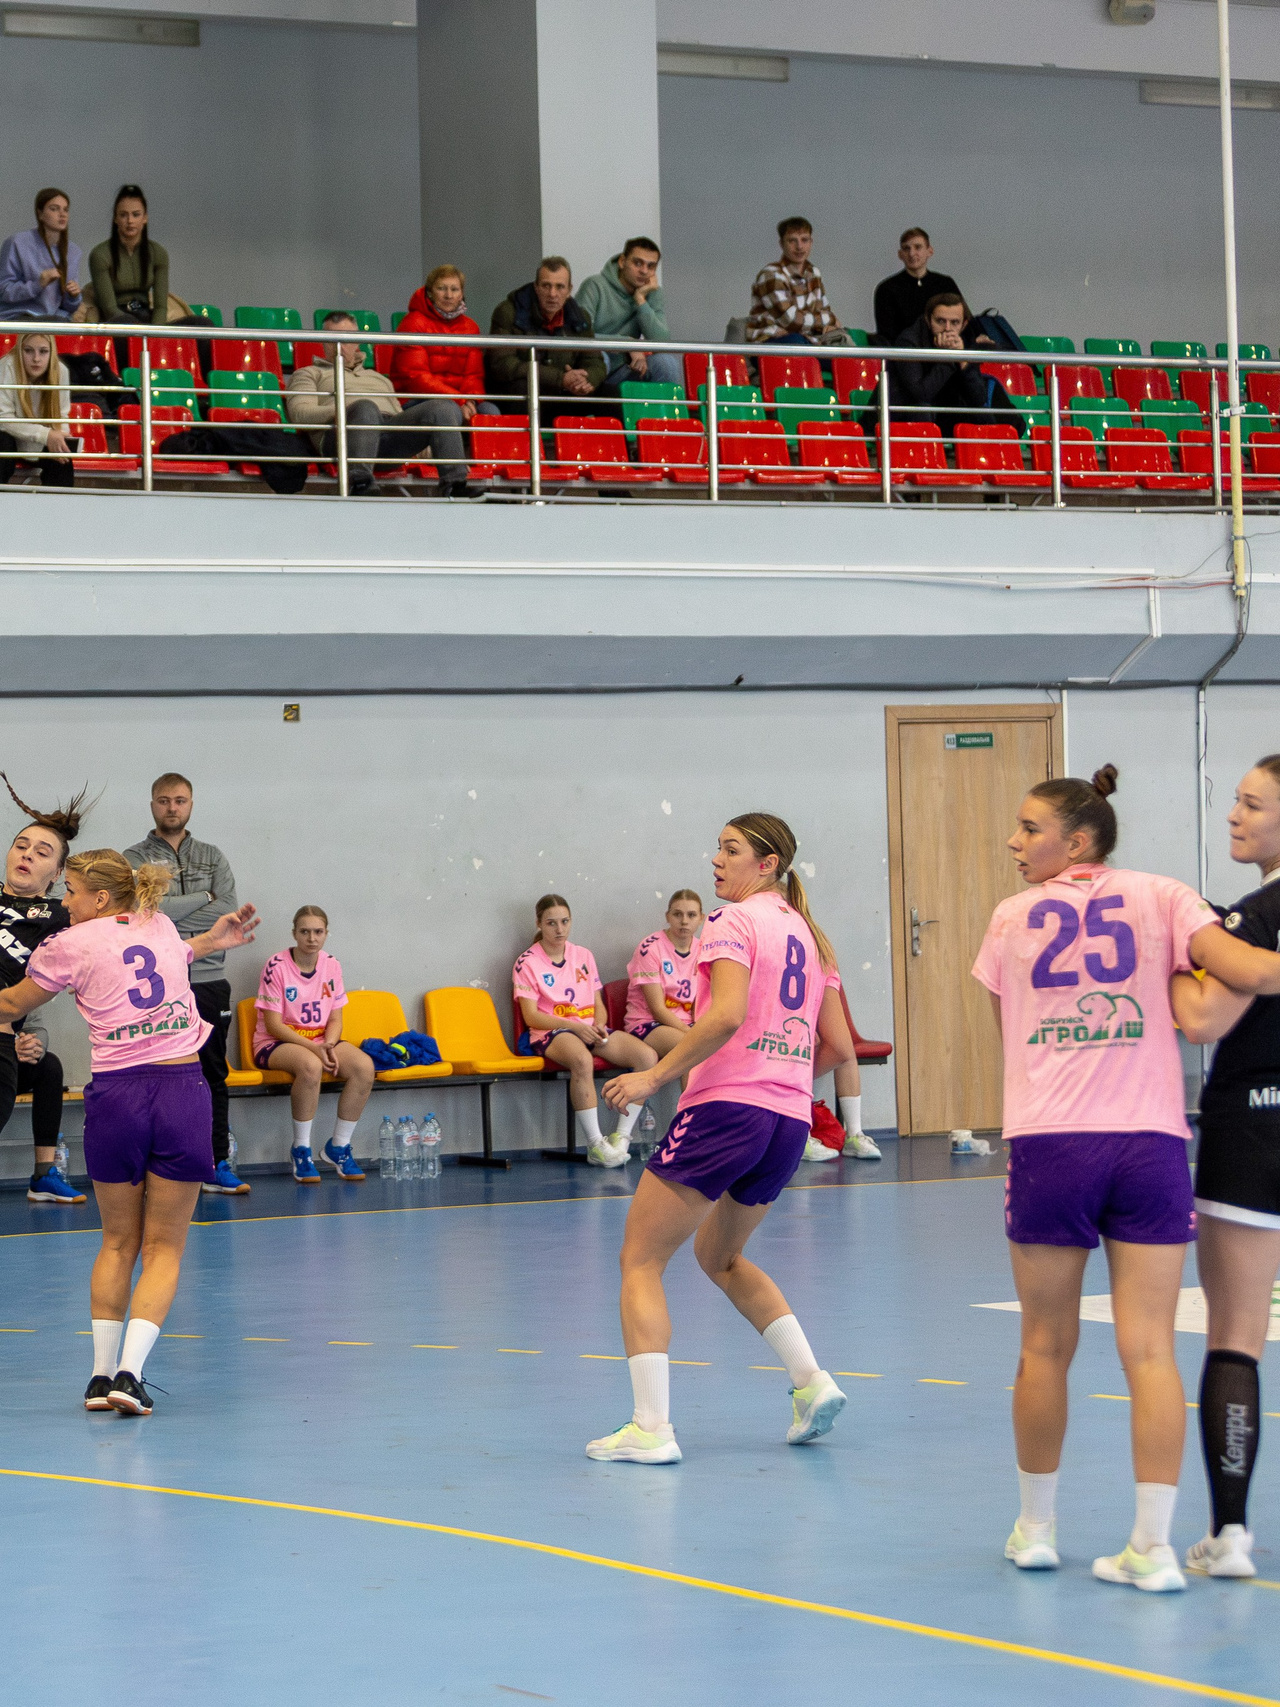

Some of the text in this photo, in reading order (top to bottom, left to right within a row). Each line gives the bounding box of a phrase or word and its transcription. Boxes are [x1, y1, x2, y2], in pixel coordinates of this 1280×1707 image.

[122, 944, 166, 1010] 3
[779, 934, 806, 1010] 8
[1027, 894, 1136, 989] 25
[300, 1000, 322, 1024] 55
[1221, 1402, 1253, 1477] Kempa
